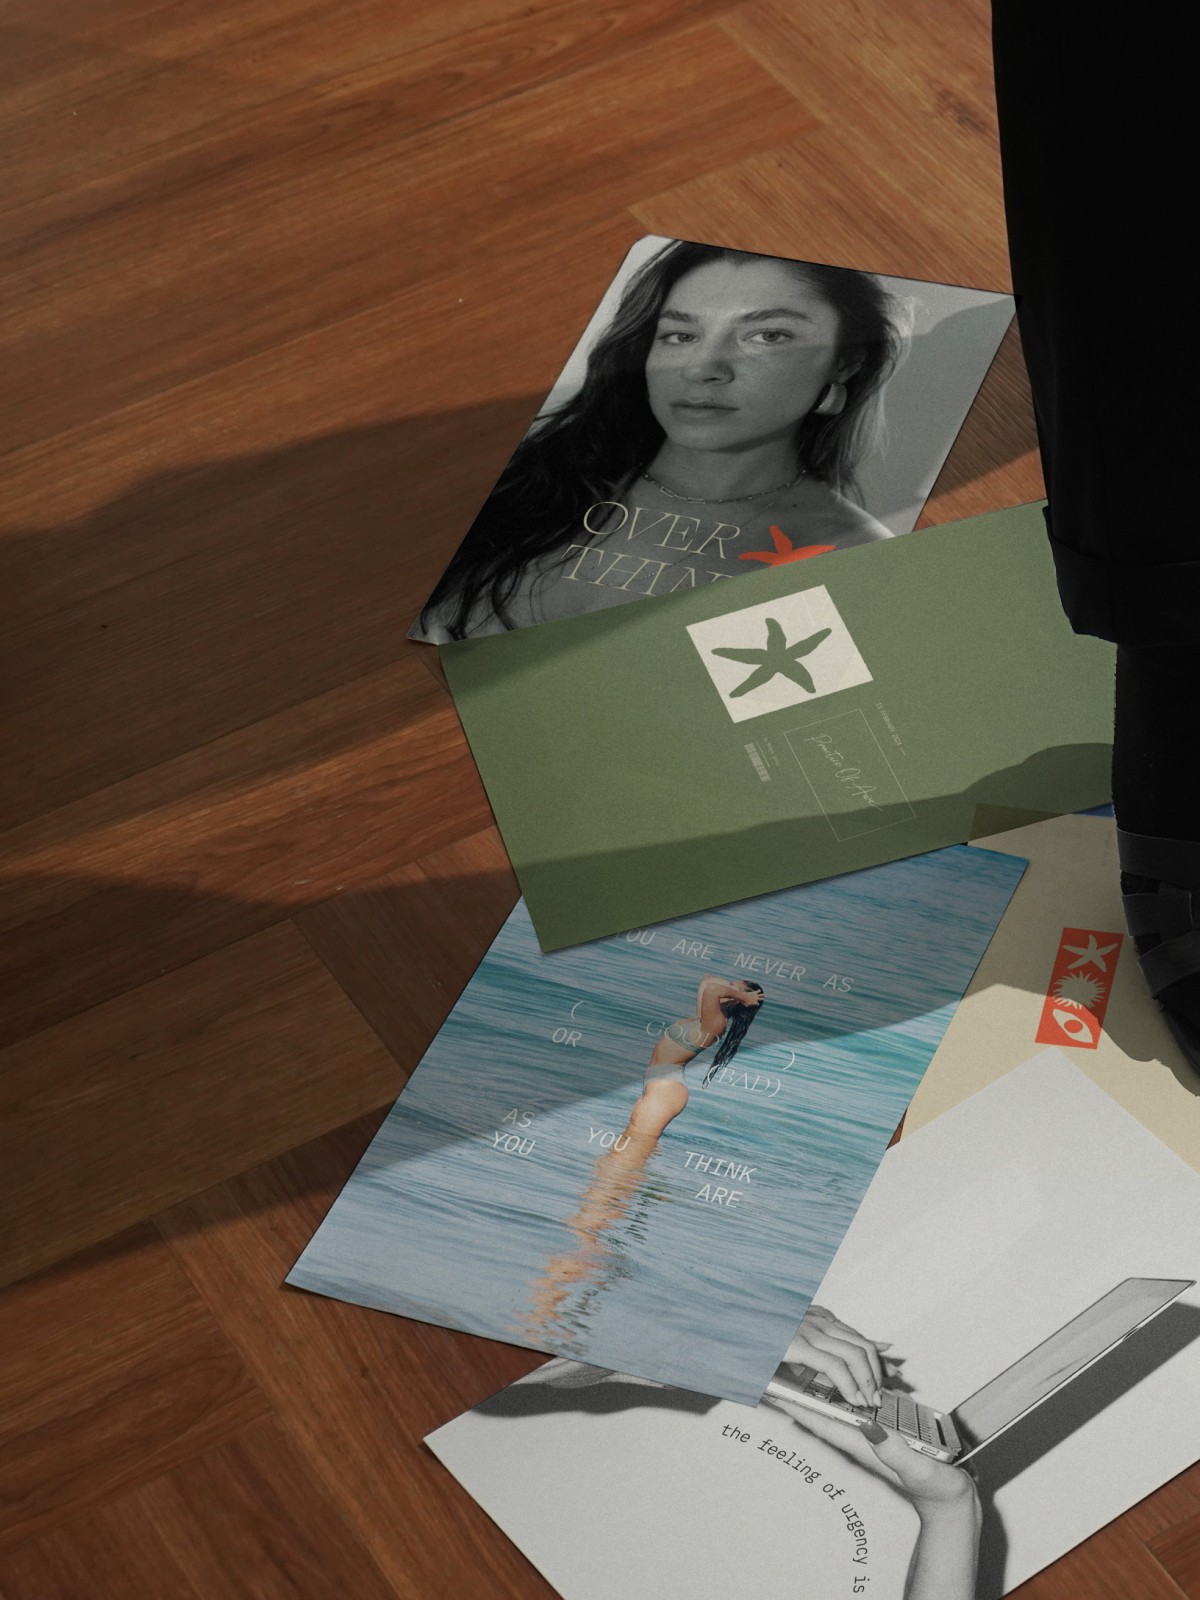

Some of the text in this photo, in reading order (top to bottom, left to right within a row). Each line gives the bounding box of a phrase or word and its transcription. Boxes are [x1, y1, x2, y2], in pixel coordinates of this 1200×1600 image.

[583, 501, 741, 560] OVER
[616, 929, 855, 994] OU ARE NEVER AS
[551, 1027, 781, 1098] OR (BAD)
[645, 1020, 720, 1049] GOOD
[491, 1131, 744, 1209] YOU ARE
[502, 1108, 758, 1184] AS YOU THINK
[721, 1424, 870, 1594] the feeling of urgency is
